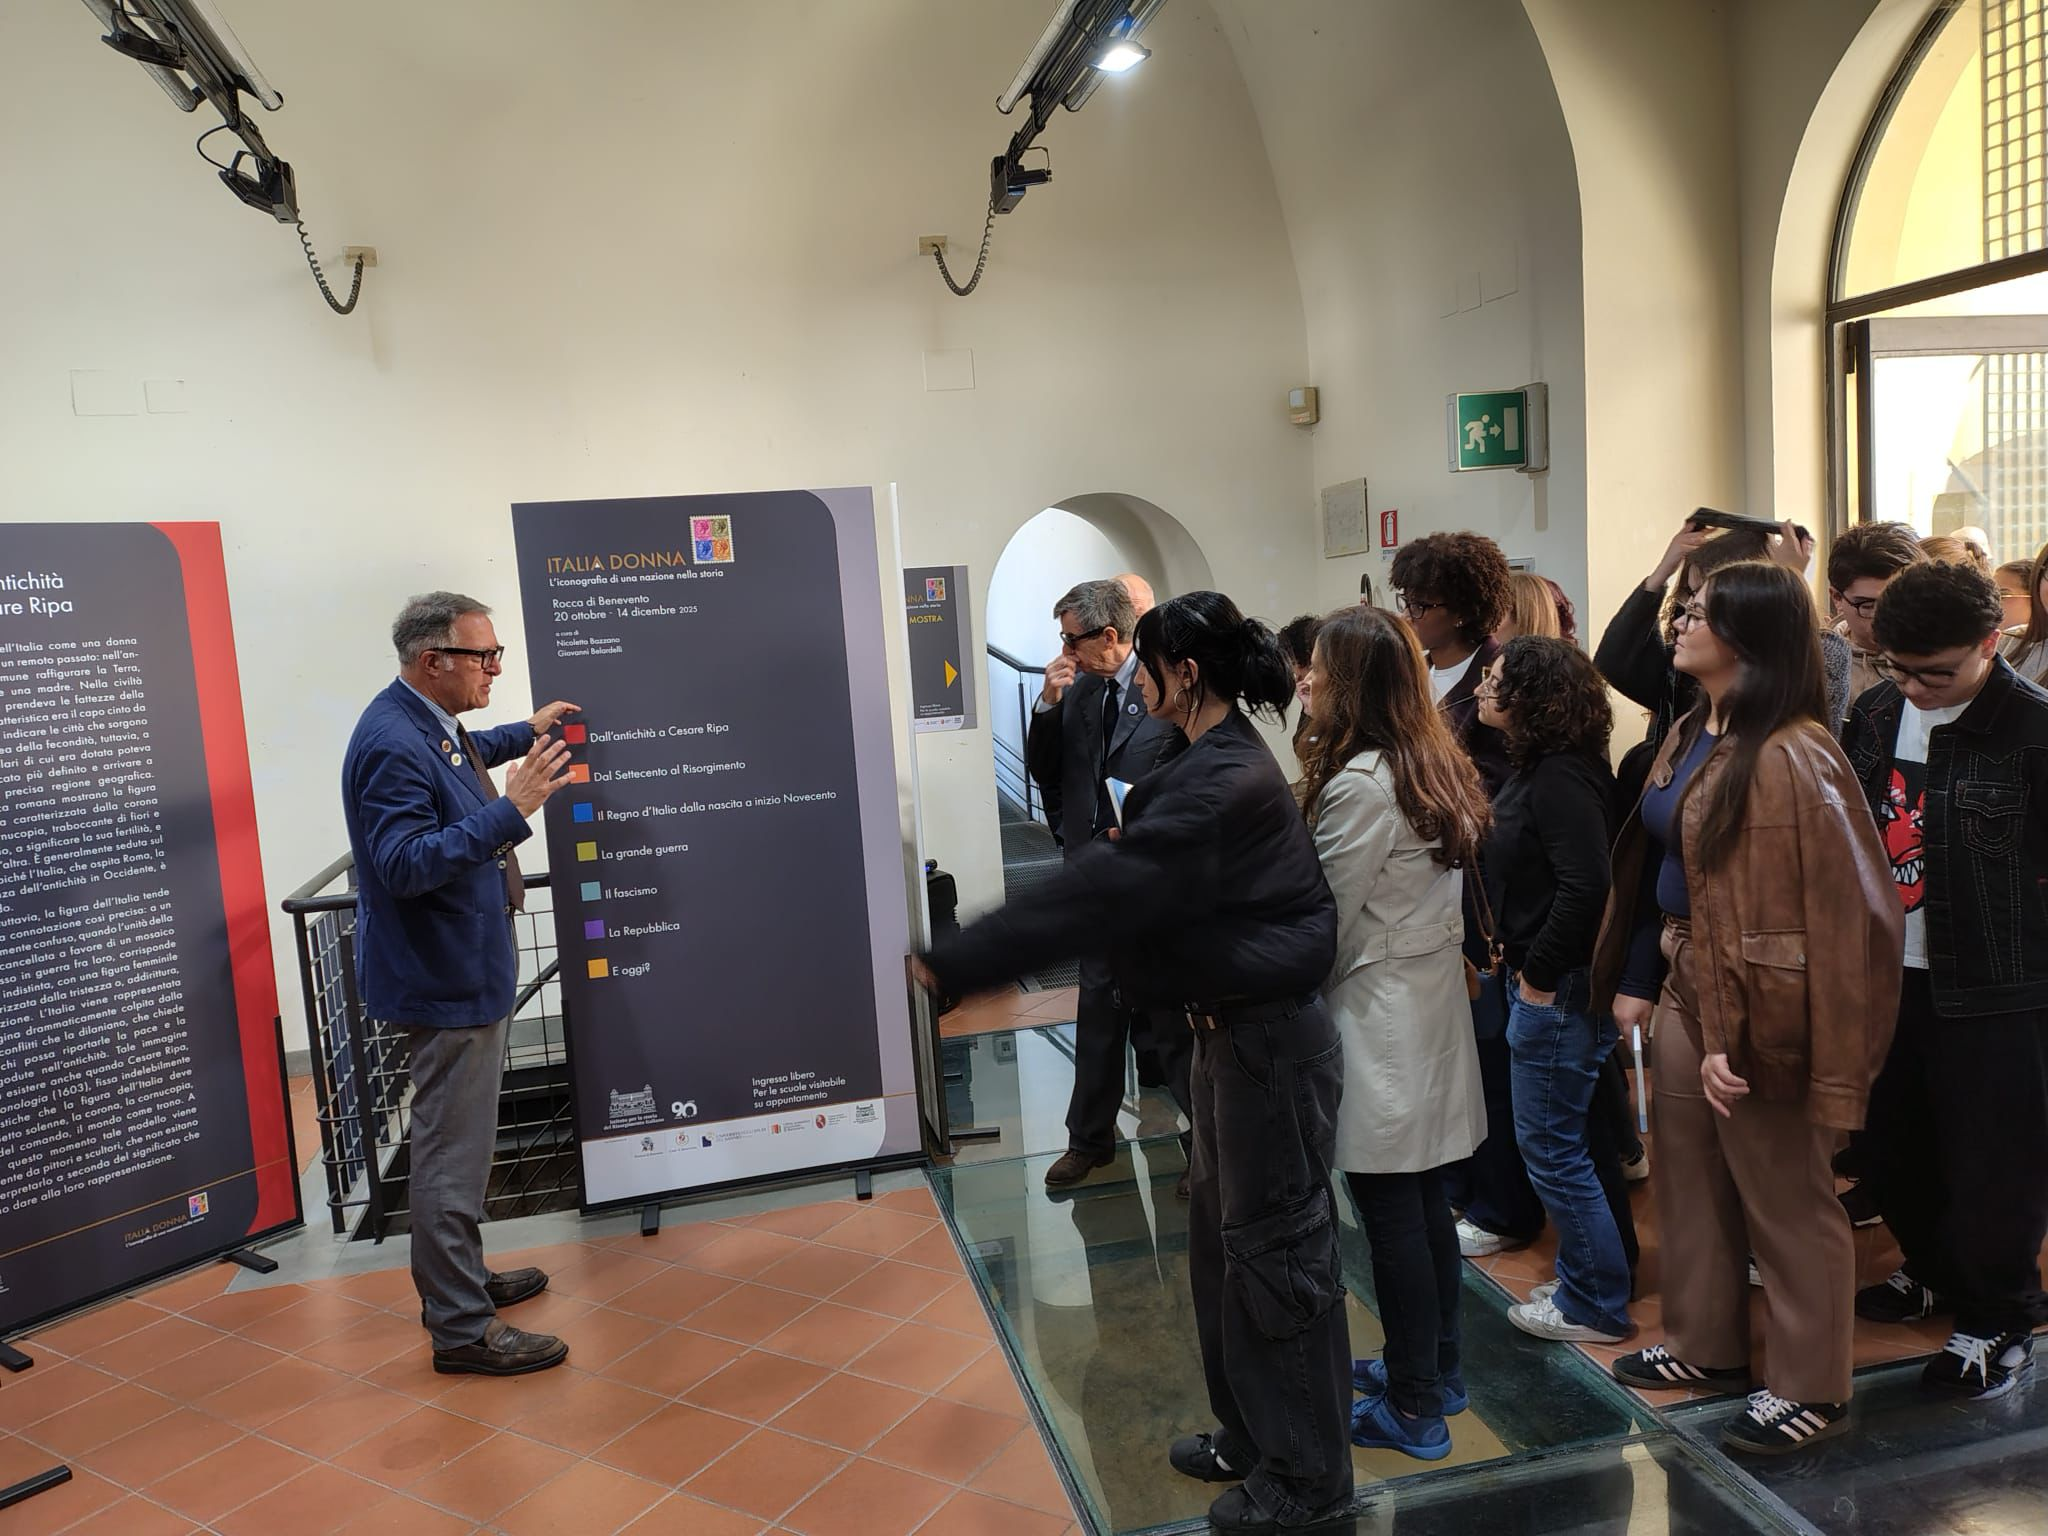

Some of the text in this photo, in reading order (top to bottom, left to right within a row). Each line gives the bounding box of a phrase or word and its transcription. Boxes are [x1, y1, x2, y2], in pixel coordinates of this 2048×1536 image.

[548, 551, 687, 573] ITALIA DONNA
[550, 574, 608, 588] L'iconografia
[610, 573, 619, 584] di
[640, 572, 675, 582] nazione
[677, 569, 698, 580] nella
[700, 568, 724, 578] storia
[29, 596, 73, 618] Ripa
[553, 594, 650, 609] Rocca di Benevento
[554, 611, 569, 622] 20
[571, 608, 607, 621] ottobre
[617, 607, 629, 618] 14
[631, 604, 676, 617] dicembre
[679, 605, 698, 614] 2025
[910, 615, 943, 624] MOSTRA
[17, 656, 54, 666] remoto
[56, 653, 100, 666] passato:
[102, 649, 139, 660] nell'an-
[6, 689, 144, 712] prendeva le fattezze della
[2, 718, 148, 740] indicare le città che sorgono
[590, 728, 656, 743] Dall'antichità
[668, 725, 704, 736] Cesare
[707, 723, 729, 735] Ripa
[594, 761, 746, 782] Dal Settecento al Risorgimento
[4, 770, 154, 800] precisa regione geografica.
[598, 810, 604, 821] Il
[607, 810, 640, 822] Regno
[642, 804, 678, 817] d'Italia
[680, 801, 706, 814] dalla
[708, 800, 744, 811] nascita
[755, 795, 781, 806] inizio
[784, 790, 837, 804] Novecento
[1, 826, 48, 841] nucopia,
[52, 817, 113, 833] traboccante
[116, 813, 127, 823] di
[130, 810, 150, 821] fiori
[602, 844, 689, 861] La grande guerra
[44, 909, 56, 919] la
[58, 904, 90, 917] figura
[92, 893, 140, 910] dell'Italia
[142, 887, 170, 900] tende
[605, 887, 658, 899] Il fascismo
[33, 935, 77, 949] confuso,
[78, 925, 117, 942] quando
[117, 918, 148, 932] l'unità
[148, 913, 173, 926] della
[609, 921, 680, 938] La Repubblica
[3, 952, 178, 999] indistinta, con una figura femminile
[613, 962, 650, 977] E oggi?
[0, 980, 181, 1028] zione. L'Italia viene rappresentata
[41, 1034, 61, 1046] che
[64, 1031, 75, 1041] la
[78, 1020, 129, 1037] dilaniano,
[132, 1012, 150, 1024] che
[152, 1003, 184, 1018] chiede
[0, 1059, 17, 1071] chi
[24, 1051, 56, 1067] possa
[62, 1035, 111, 1056] riportarle
[116, 1031, 127, 1041] la
[133, 1025, 158, 1039] pace
[176, 1016, 186, 1026] la
[0, 1056, 191, 1114] onologia (1603), fissa indelebilmente
[752, 1071, 816, 1088] Ingresso libero
[753, 1076, 846, 1098] Per le scuole visitabile
[0, 1069, 192, 1128] stiche che la figura dell'Italia deve
[672, 1101, 697, 1117] 90
[766, 1091, 828, 1108] appuntamento
[7, 1107, 197, 1169] questo momento tale modello viene
[67, 1159, 110, 1179] seconda
[113, 1151, 129, 1164] del
[132, 1138, 181, 1159] significato
[183, 1131, 200, 1142] che
[0, 1154, 175, 1215] o dare alla loro rappresentazione.
[125, 1228, 150, 1242] ITALIA
[153, 1214, 187, 1232] DONNA
